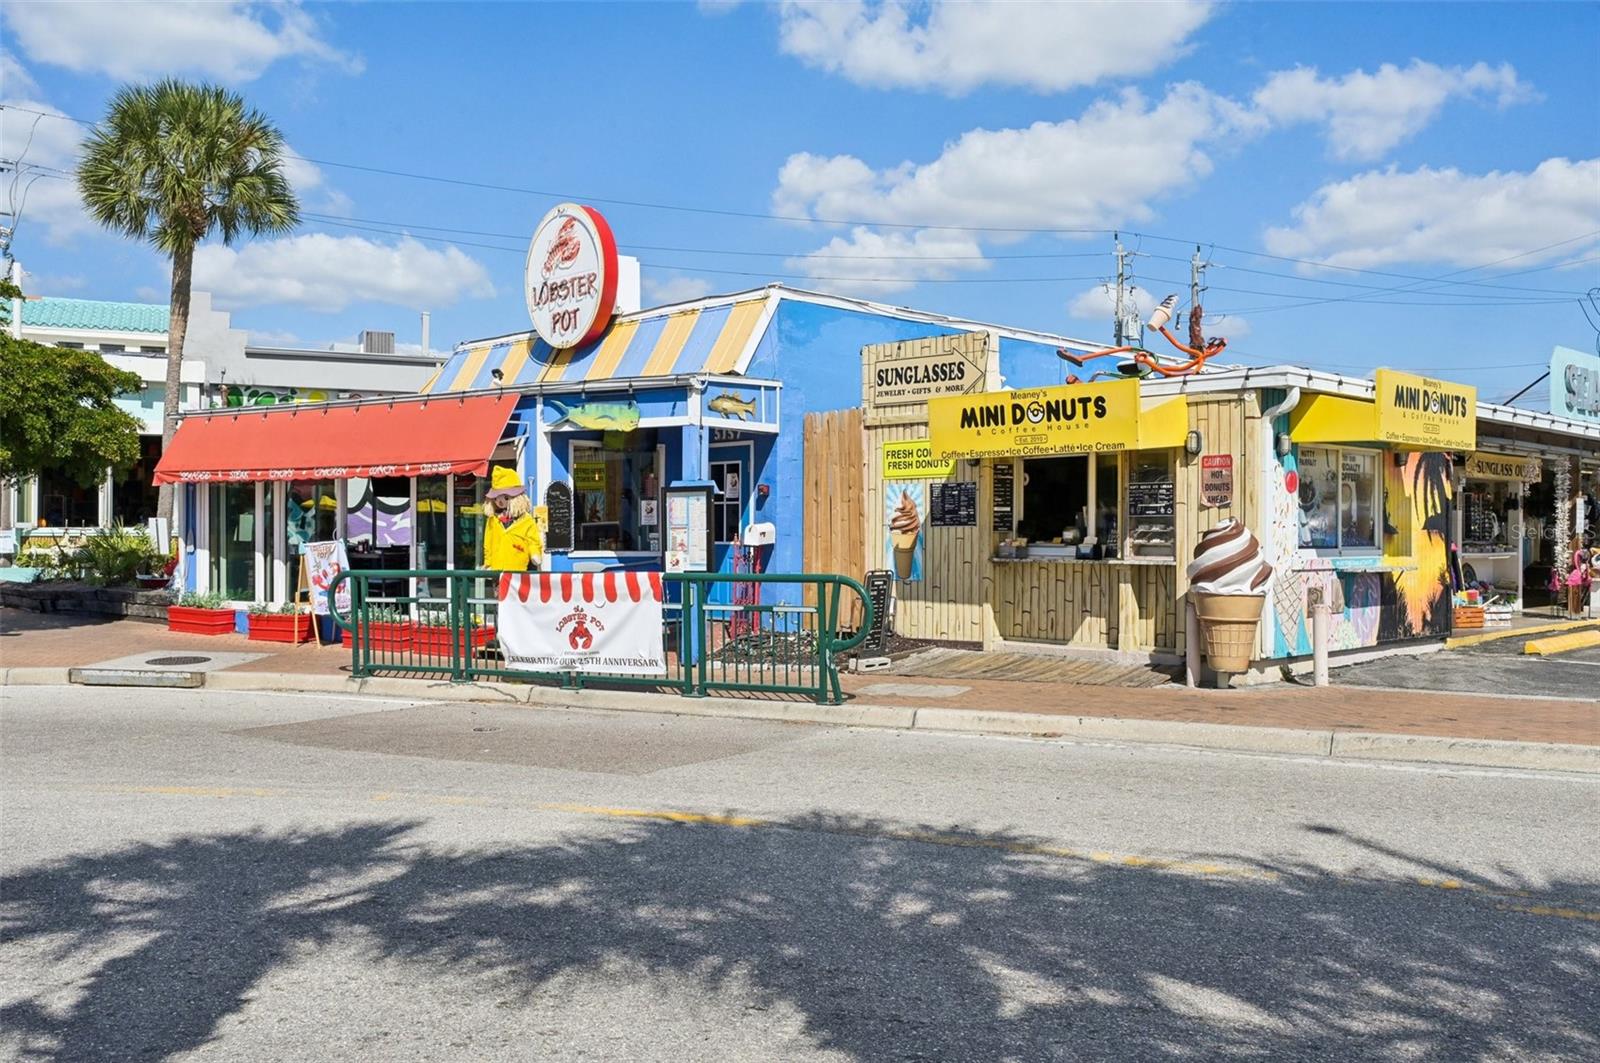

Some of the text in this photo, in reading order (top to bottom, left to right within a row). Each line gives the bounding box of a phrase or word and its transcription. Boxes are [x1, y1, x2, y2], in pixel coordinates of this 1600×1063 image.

[532, 271, 598, 307] LOBSTER
[551, 307, 580, 334] POT
[876, 361, 965, 387] SUNGLASSES
[876, 388, 906, 398] JEWELRY
[911, 386, 932, 395] GIFTS
[945, 384, 965, 393] MORE
[1010, 389, 1048, 400] Meaney's
[1394, 384, 1467, 418] MINI DONUTS
[960, 395, 1107, 429] MINI DONUTS
[714, 429, 741, 441] 5157
[991, 426, 1037, 435] Coffee
[1047, 422, 1090, 432] House
[886, 448, 914, 460] FRESH
[941, 450, 966, 459] Coffee
[969, 449, 1006, 458] Espresso
[1009, 447, 1021, 455] Ice
[1022, 445, 1050, 455] Coffee
[1079, 443, 1093, 451] Ice
[1095, 441, 1126, 451] Cream
[888, 458, 950, 470] FRESH DONUTS
[1204, 457, 1231, 466] CAUTION
[1477, 459, 1513, 477] SUNGLASS
[1210, 470, 1223, 479] HOT
[1204, 482, 1230, 492] DONUTS
[1206, 495, 1229, 504] AHEAD
[556, 612, 605, 633] LOBSTER POT
[508, 655, 660, 668] CELEBRATING OUR 25TH ANNIVERSARY
